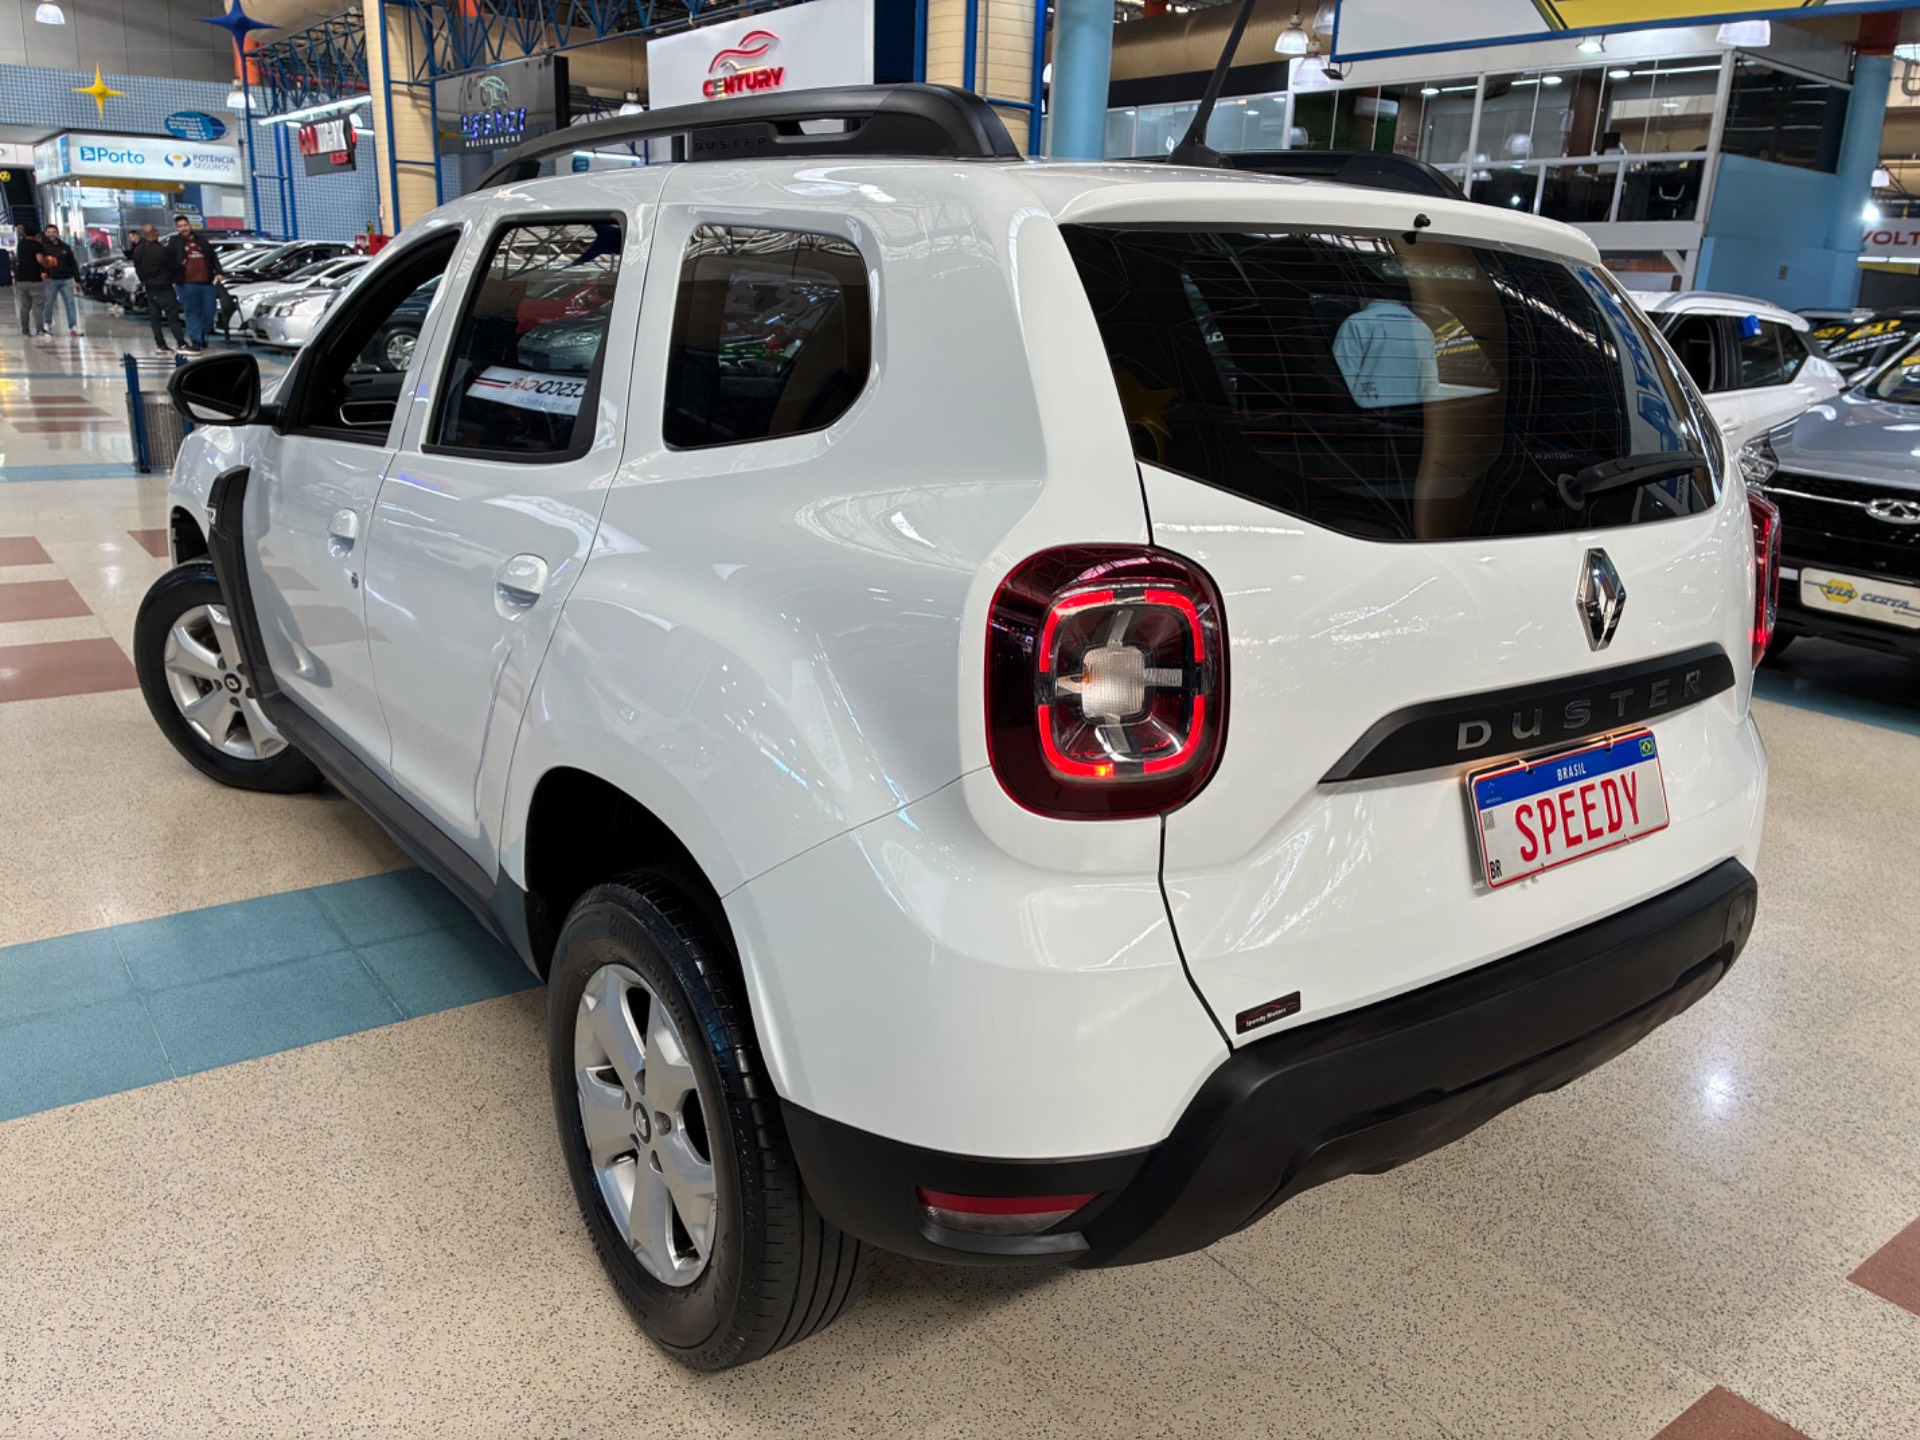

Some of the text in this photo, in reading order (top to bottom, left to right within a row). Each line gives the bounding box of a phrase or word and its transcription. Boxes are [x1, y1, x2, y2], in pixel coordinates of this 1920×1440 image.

[703, 67, 784, 98] CENTURY
[695, 136, 766, 151] DUSTER
[97, 148, 145, 165] Porto
[193, 153, 236, 165] POTÊNCIA
[193, 161, 231, 172] SEGUROS
[1826, 585, 1909, 609] VIA CERTA
[1457, 669, 1701, 751] DUSTER
[1557, 762, 1587, 782] BRASIL
[1514, 770, 1640, 862] SPEEDY
[1489, 859, 1503, 880] BR
